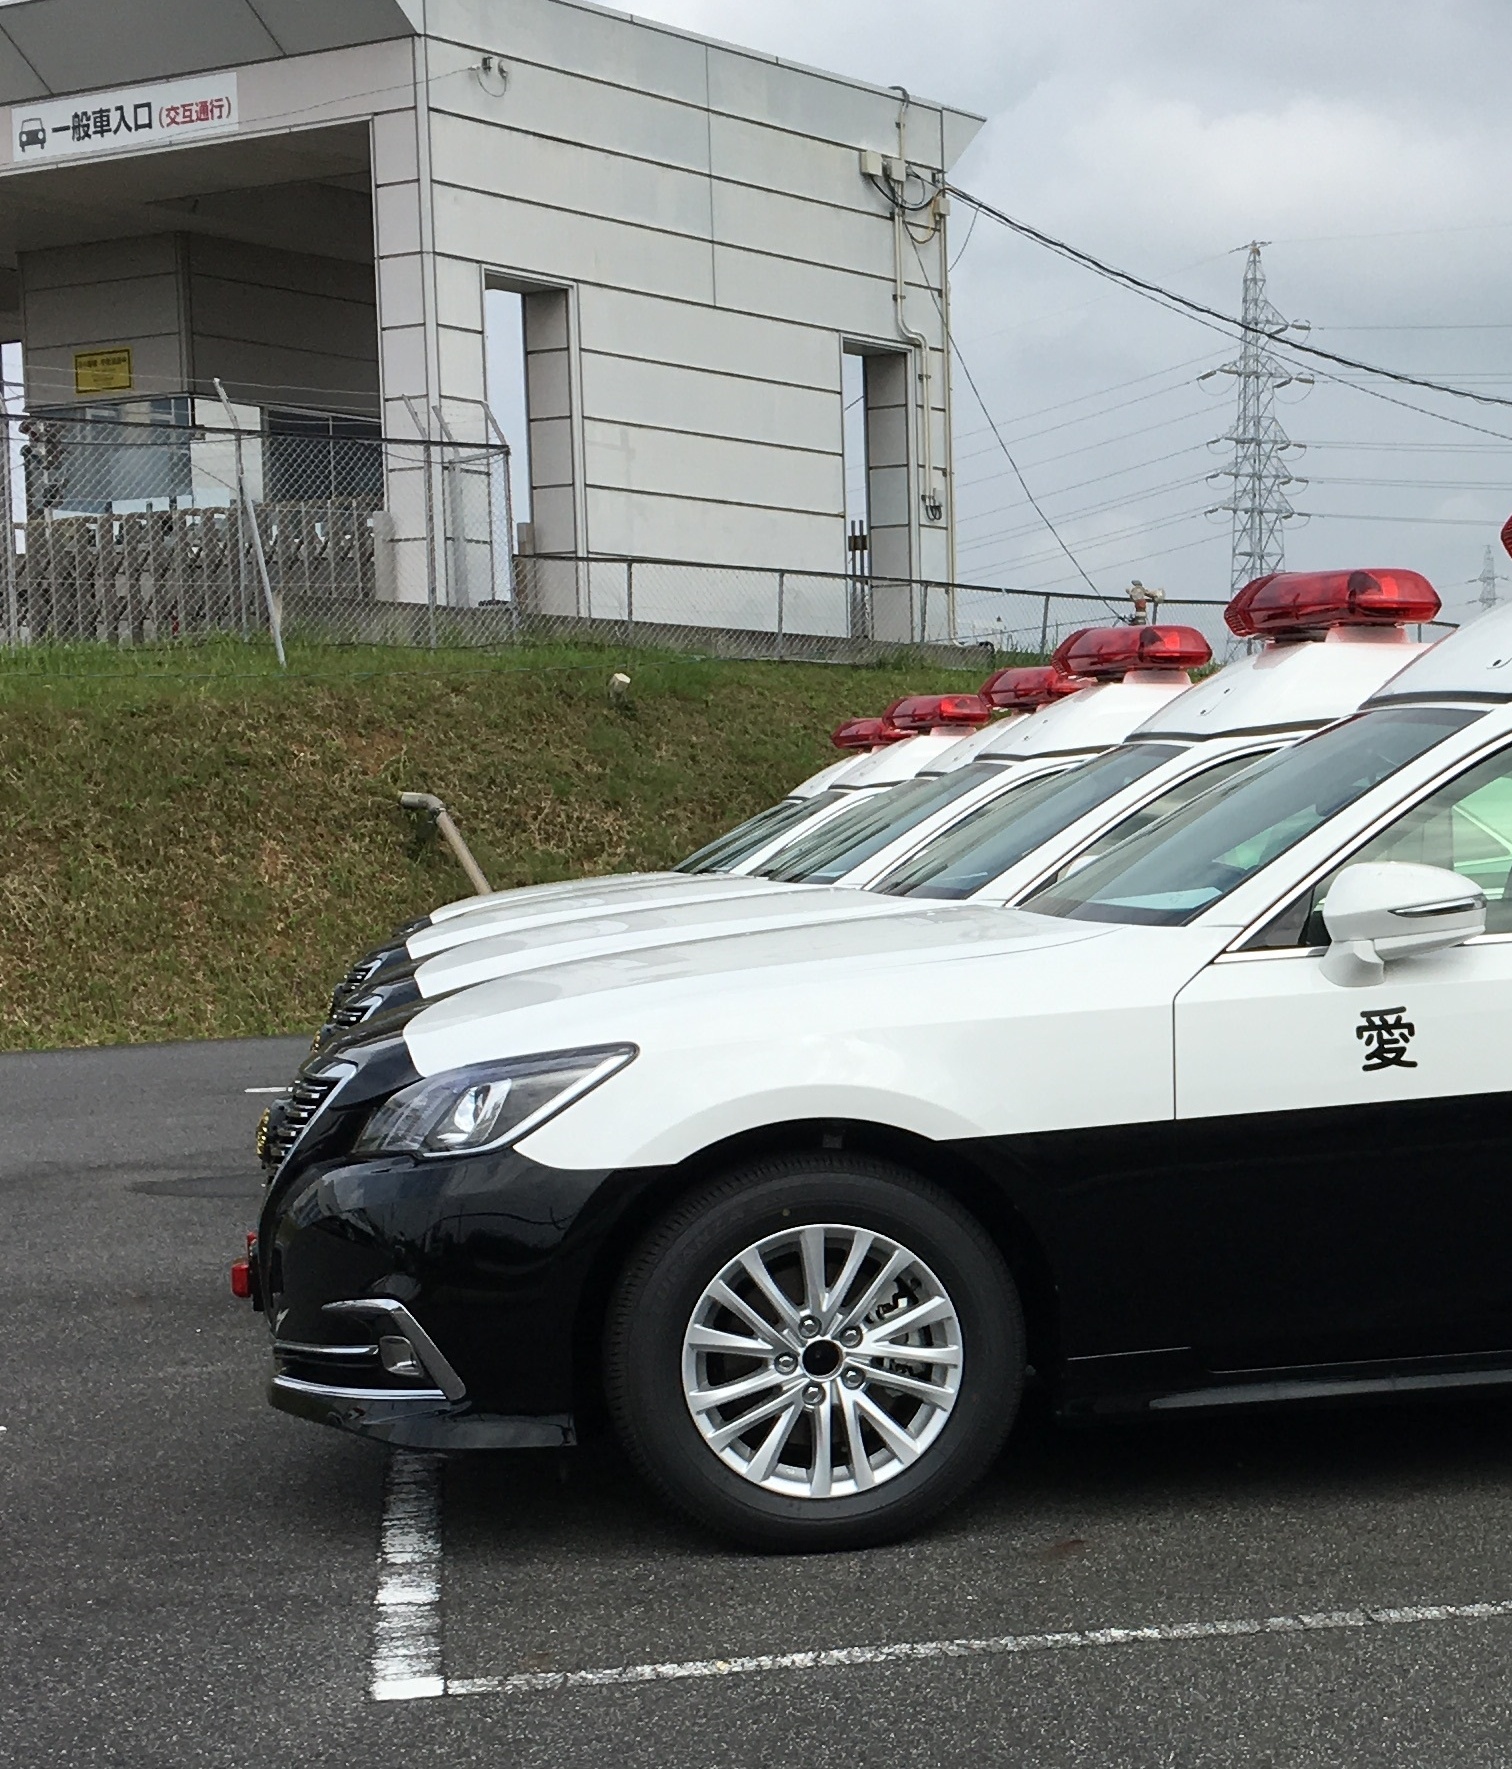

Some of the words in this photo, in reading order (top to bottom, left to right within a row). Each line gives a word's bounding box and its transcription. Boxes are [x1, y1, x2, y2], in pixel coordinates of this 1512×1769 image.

[51, 102, 153, 142] 一般車入口
